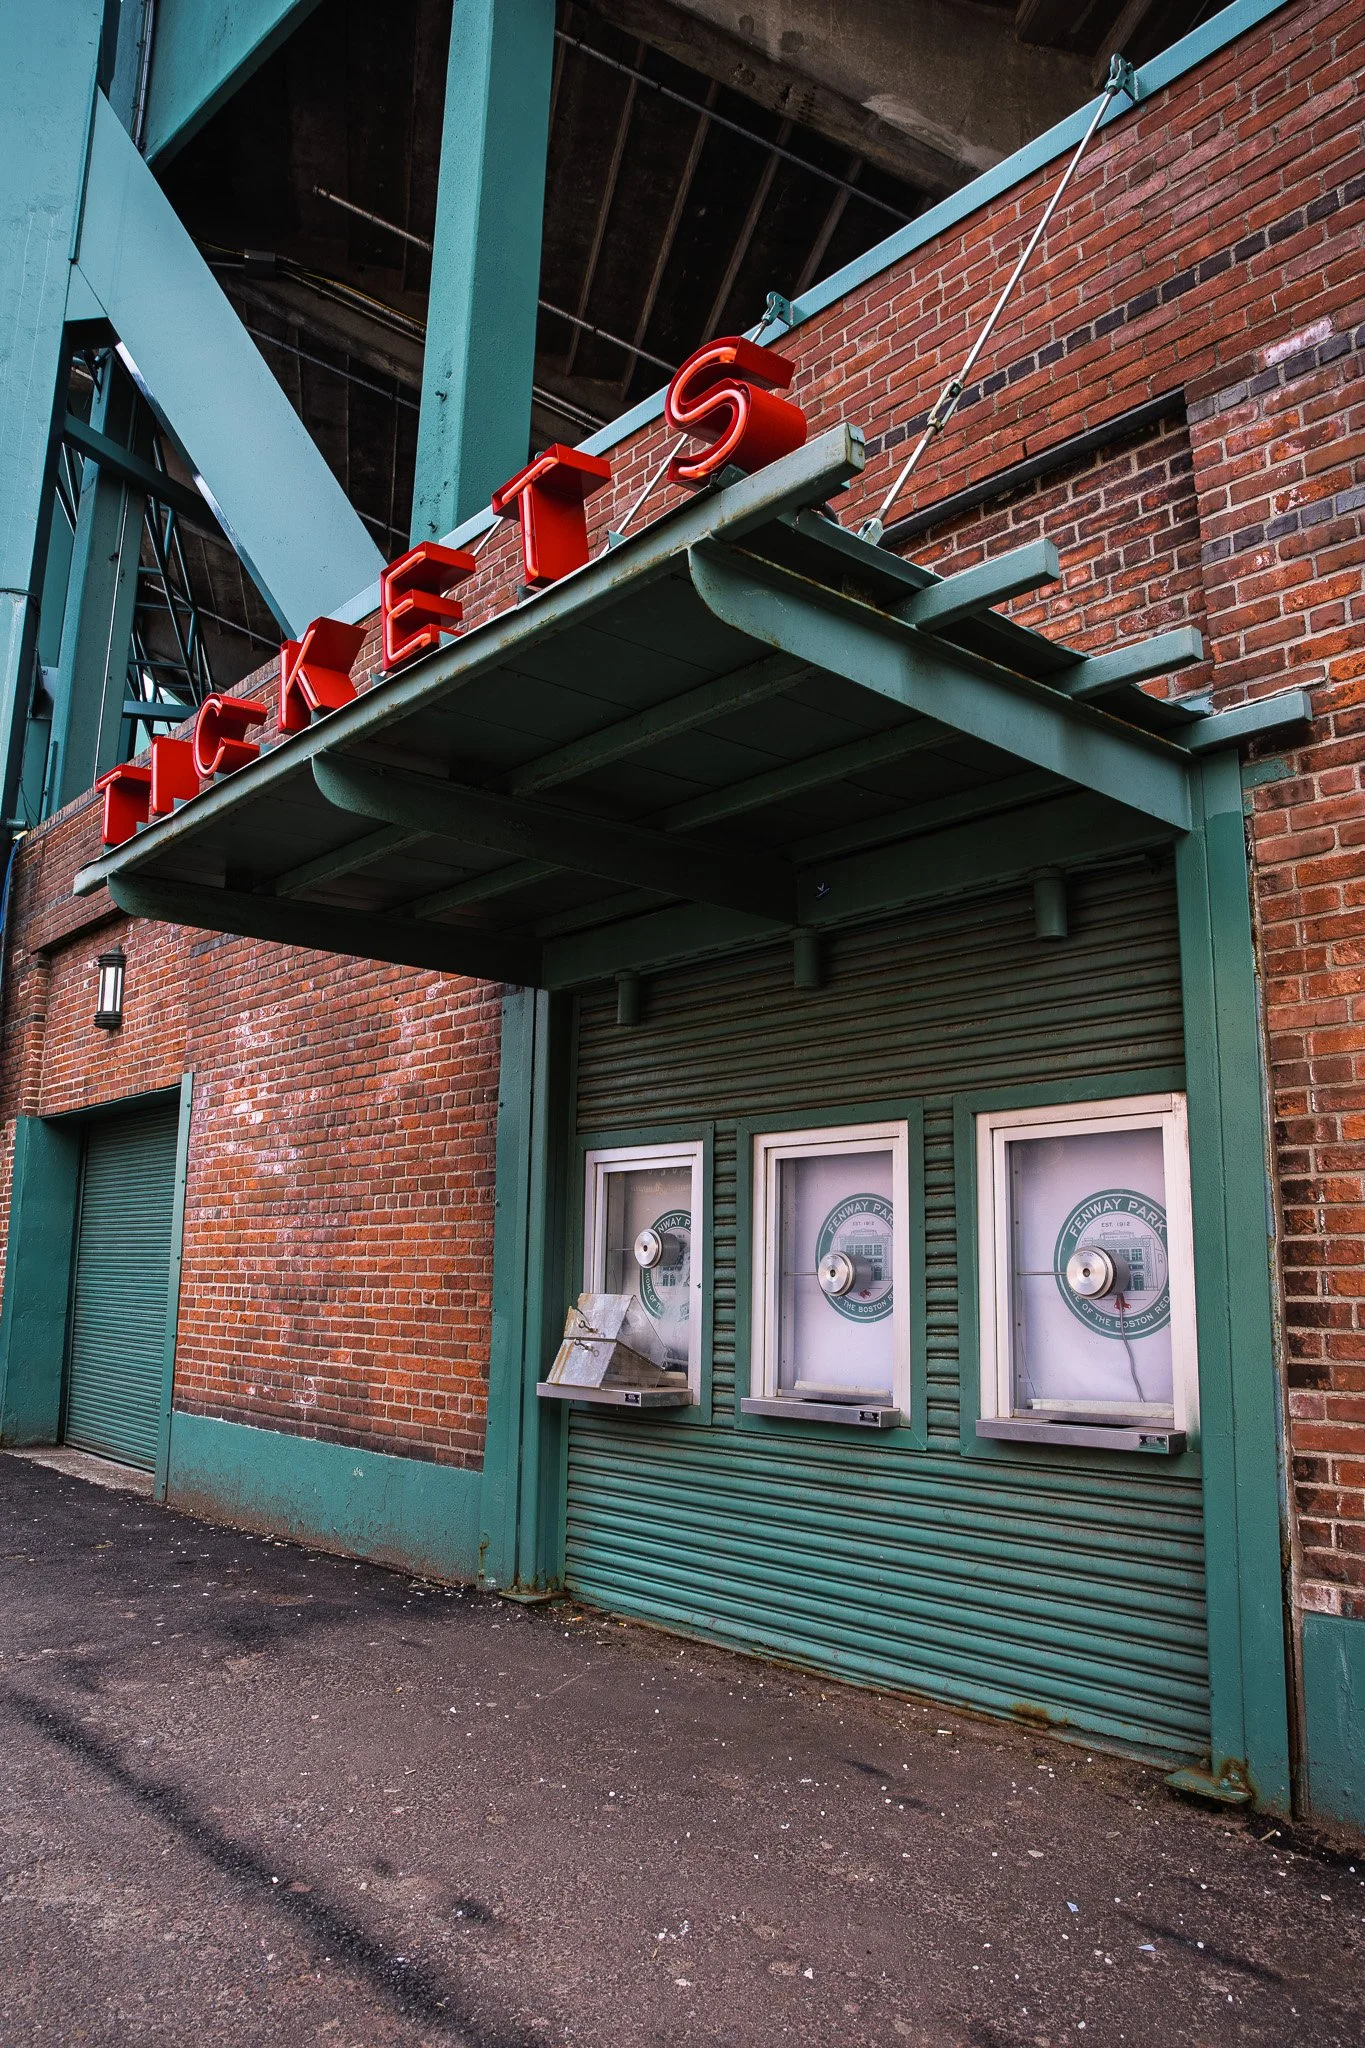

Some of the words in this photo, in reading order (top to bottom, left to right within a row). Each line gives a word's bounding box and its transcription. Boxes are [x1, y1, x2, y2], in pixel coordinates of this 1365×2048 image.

[95, 335, 807, 846] TICKETS
[657, 1216, 682, 1233] NWAY
[828, 1200, 869, 1235] FENWAY
[872, 1203, 893, 1228] PAR
[1069, 1198, 1122, 1238] FENWAY
[1127, 1200, 1167, 1236] PARK
[644, 1272, 653, 1294] HOME
[649, 1294, 657, 1303] OF
[843, 1299, 856, 1311] THE
[858, 1299, 887, 1313] BOSTON
[1082, 1303, 1094, 1315] OF
[1094, 1312, 1111, 1327] THE
[1115, 1312, 1154, 1328] BOSTON
[1154, 1295, 1170, 1314] RED
